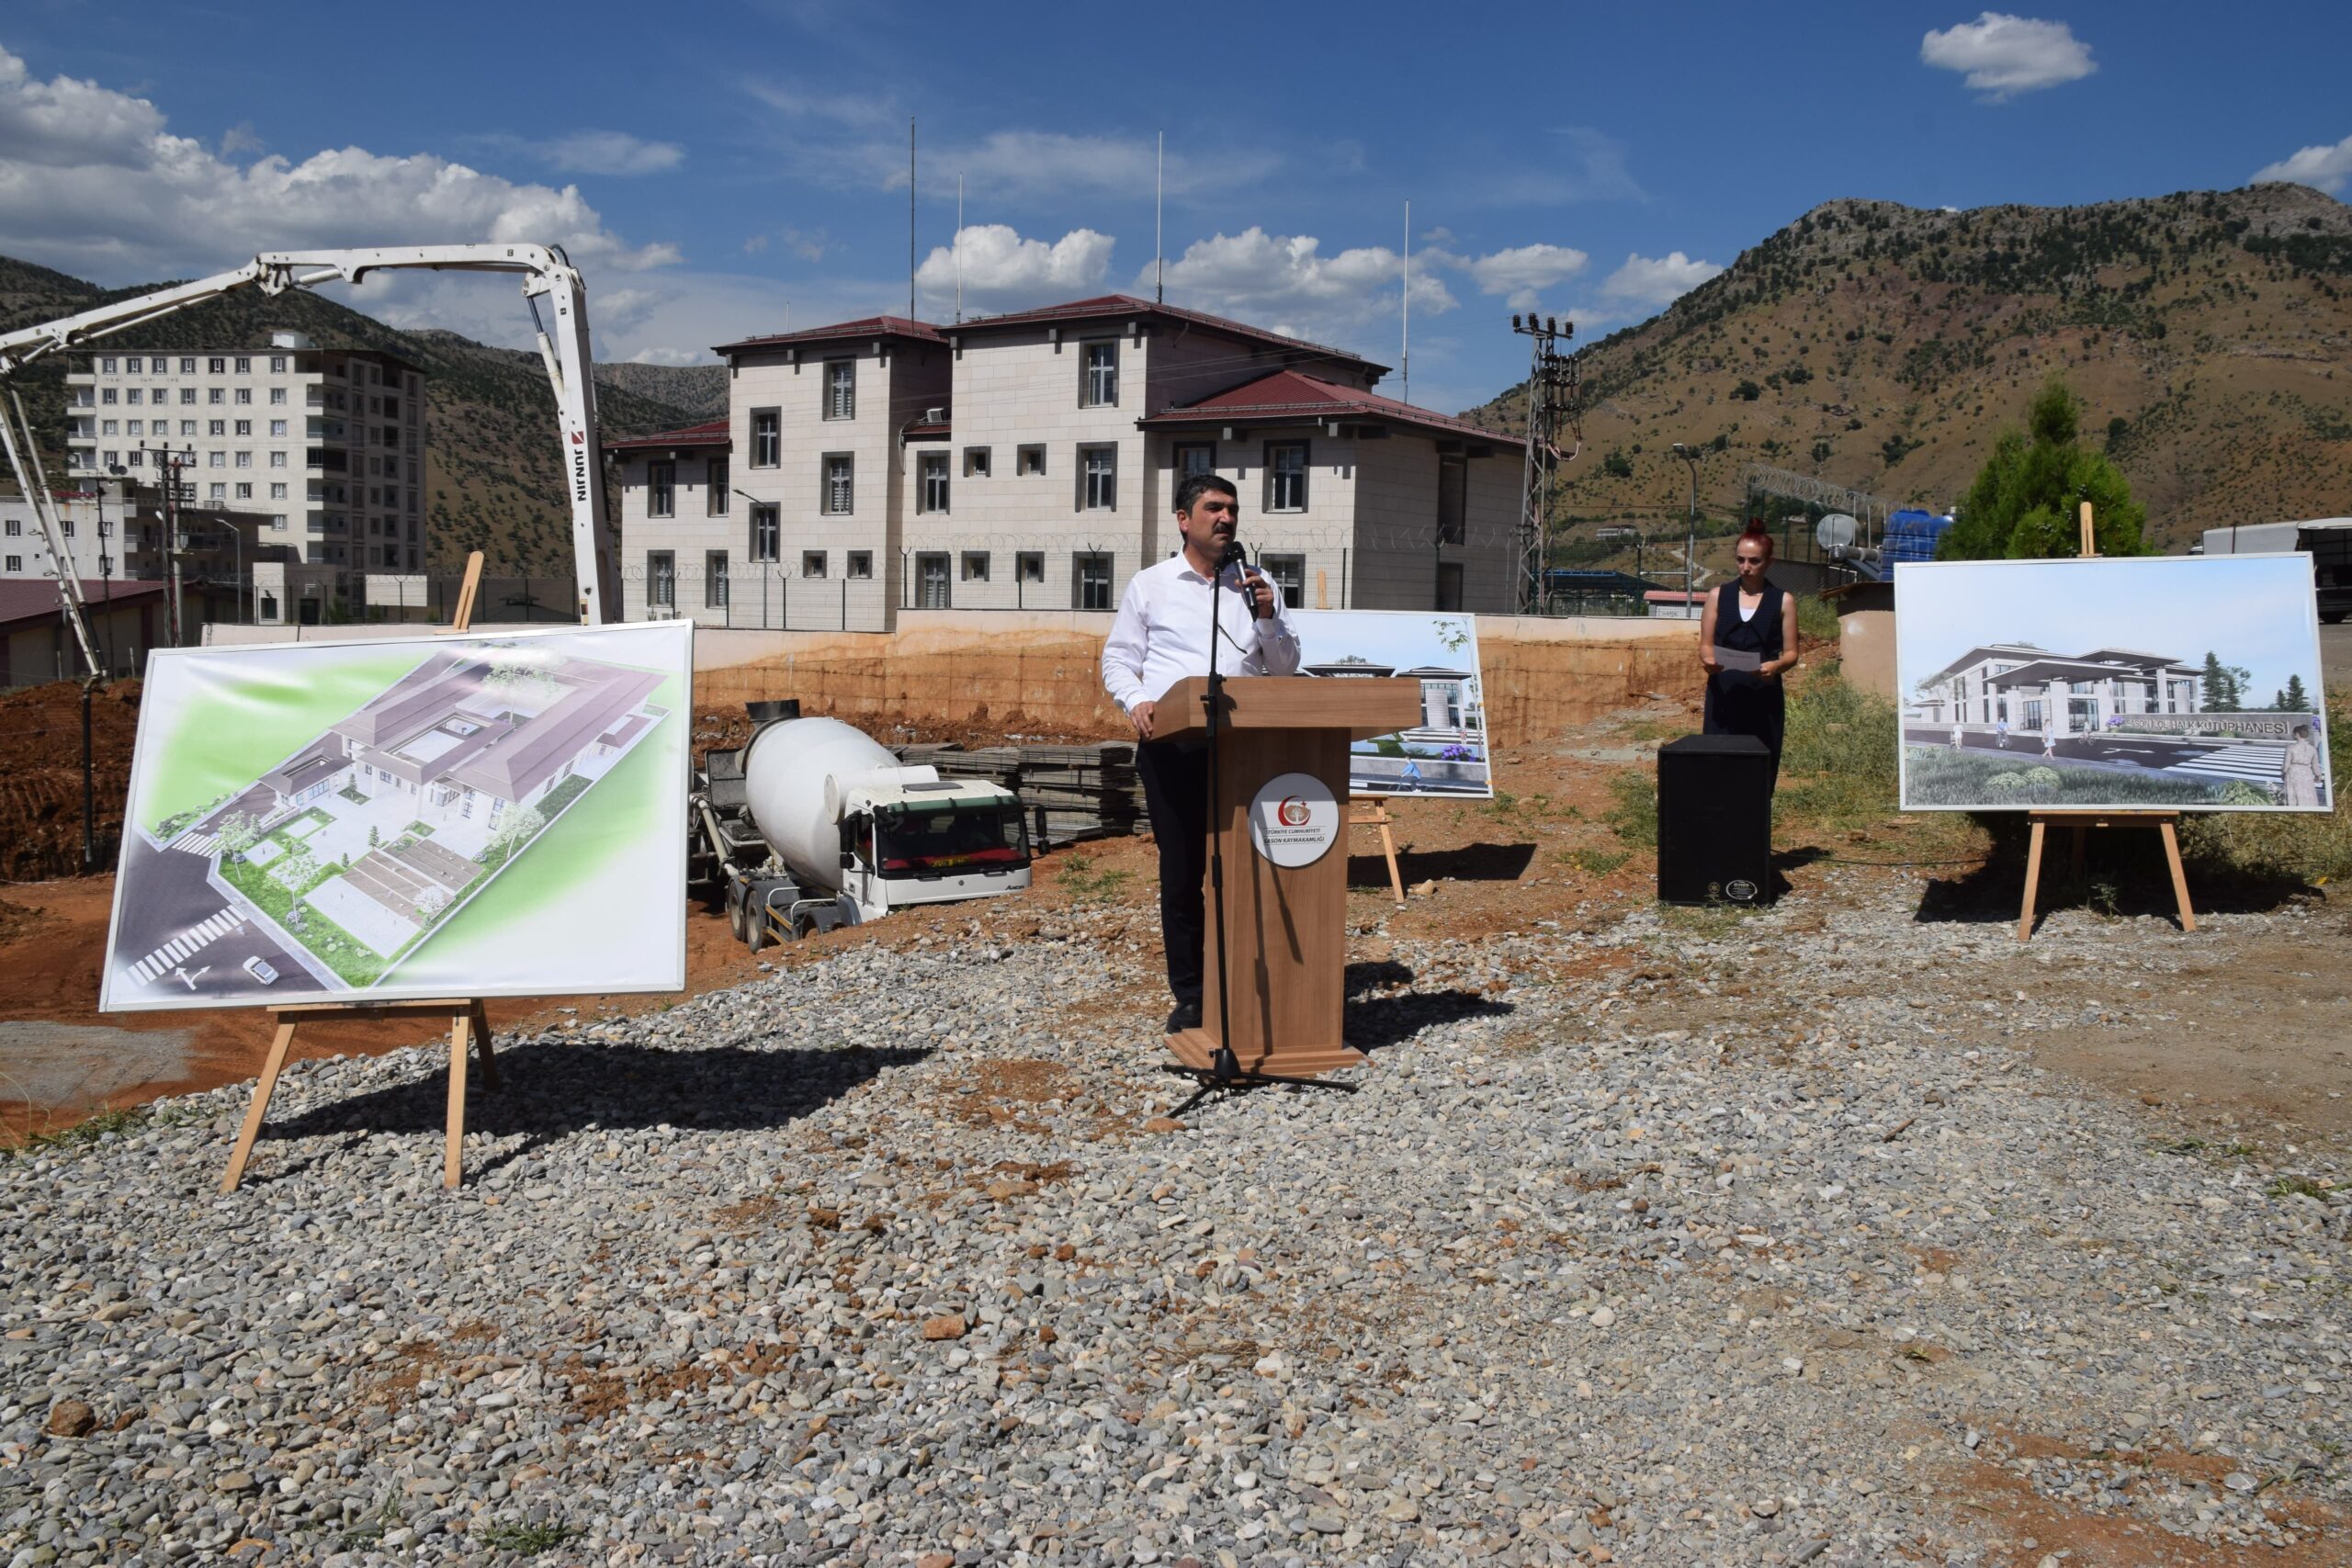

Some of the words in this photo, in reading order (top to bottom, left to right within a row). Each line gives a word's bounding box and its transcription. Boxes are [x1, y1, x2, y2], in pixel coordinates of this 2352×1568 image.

[574, 448, 587, 502] JUNJIN
[2126, 719, 2151, 728] SASON
[2171, 720, 2197, 729] HALK
[2197, 719, 2290, 735] KÜTÜPHANESİ
[1283, 835, 1325, 844] KAYMAKAMLIĞI
